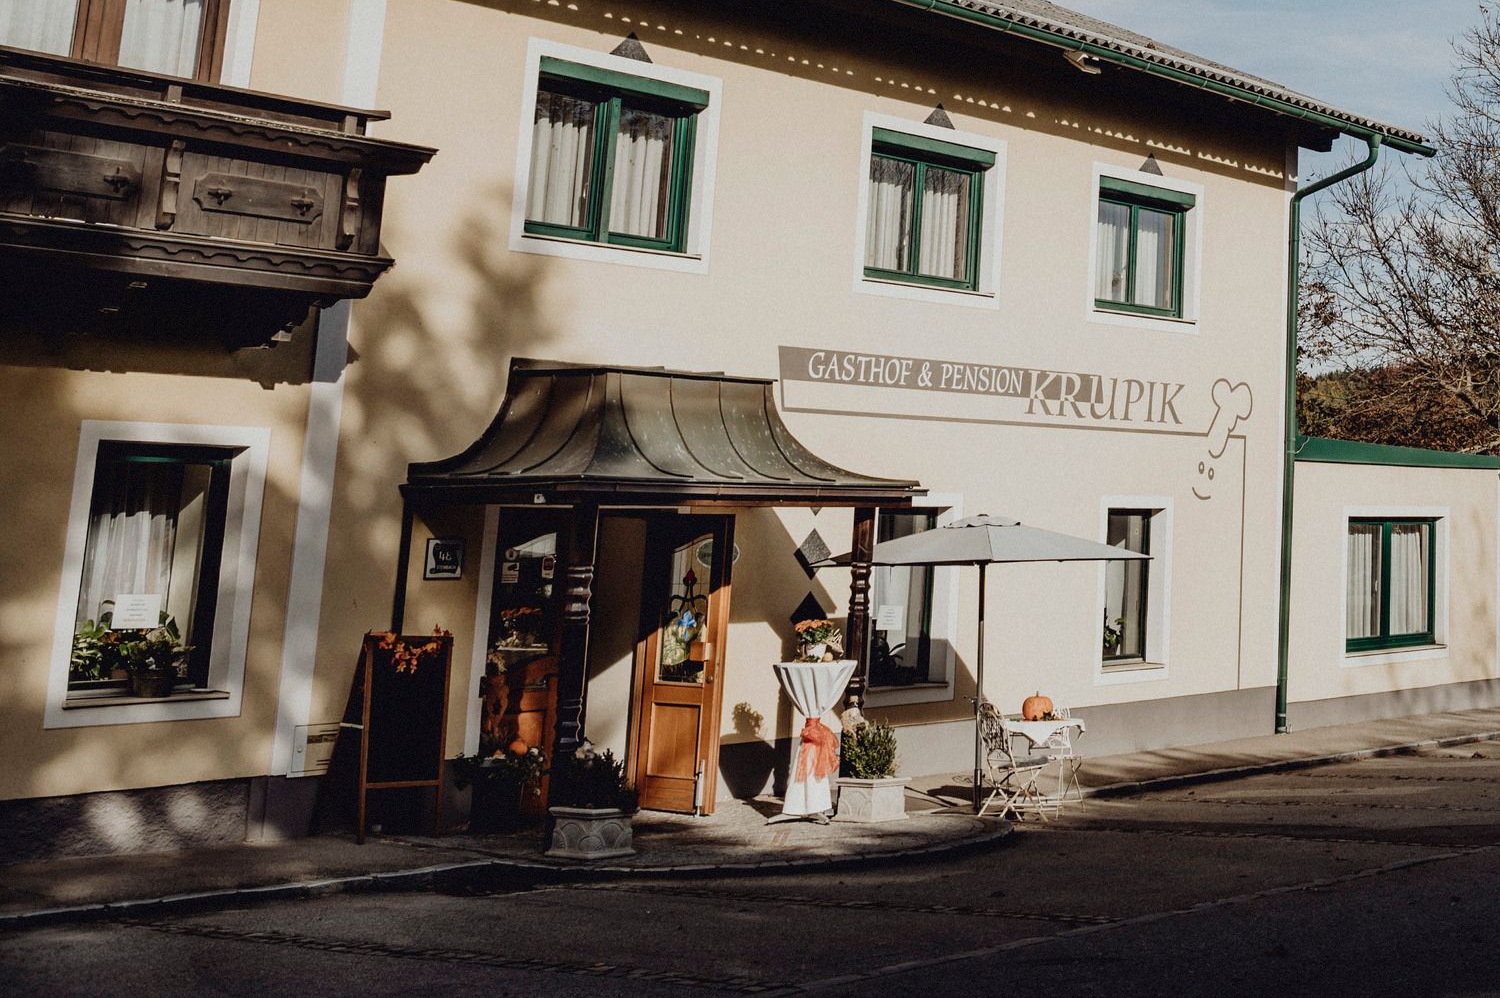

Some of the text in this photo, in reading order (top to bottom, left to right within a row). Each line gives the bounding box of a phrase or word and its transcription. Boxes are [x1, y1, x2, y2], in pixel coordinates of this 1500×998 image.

[808, 351, 1186, 424] GASTHOF & PENSION KRUPIK
